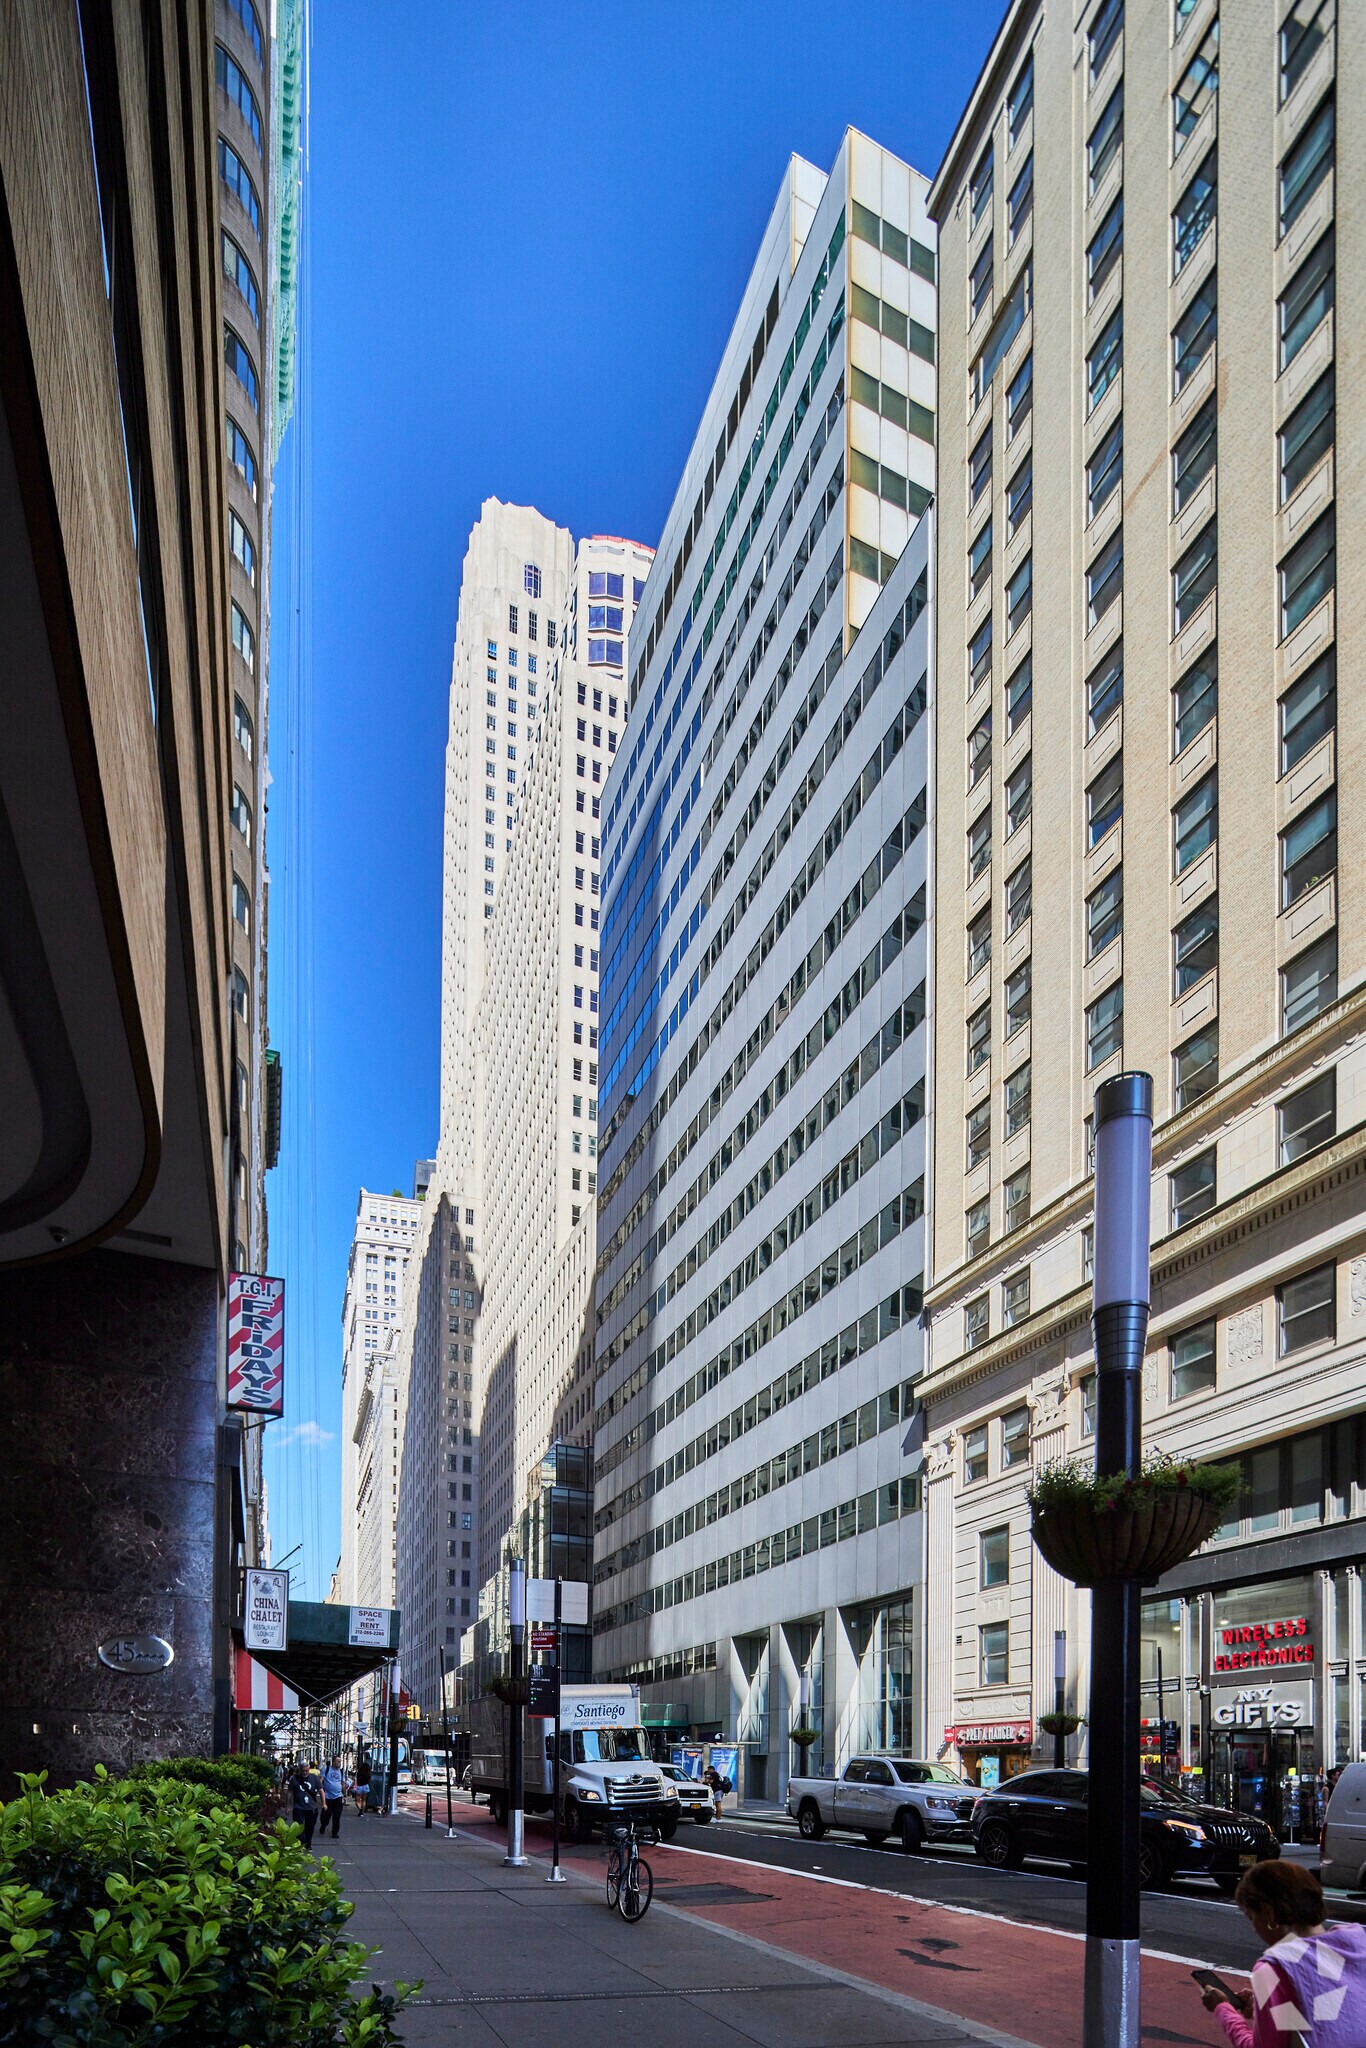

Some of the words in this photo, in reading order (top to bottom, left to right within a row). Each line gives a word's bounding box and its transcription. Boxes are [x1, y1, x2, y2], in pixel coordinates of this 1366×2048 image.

[237, 1279, 276, 1298] T.G.I.
[254, 1597, 279, 1610] CHINA
[251, 1610, 282, 1623] CHALET
[358, 1610, 383, 1618] SPACE
[1221, 1618, 1307, 1645] WIRELESS
[106, 1641, 135, 1662] 45
[1257, 1640, 1266, 1649] &
[1215, 1644, 1314, 1671] ELECTRONICS
[574, 1703, 626, 1720] Santiego
[1214, 1701, 1302, 1725] GIFTS
